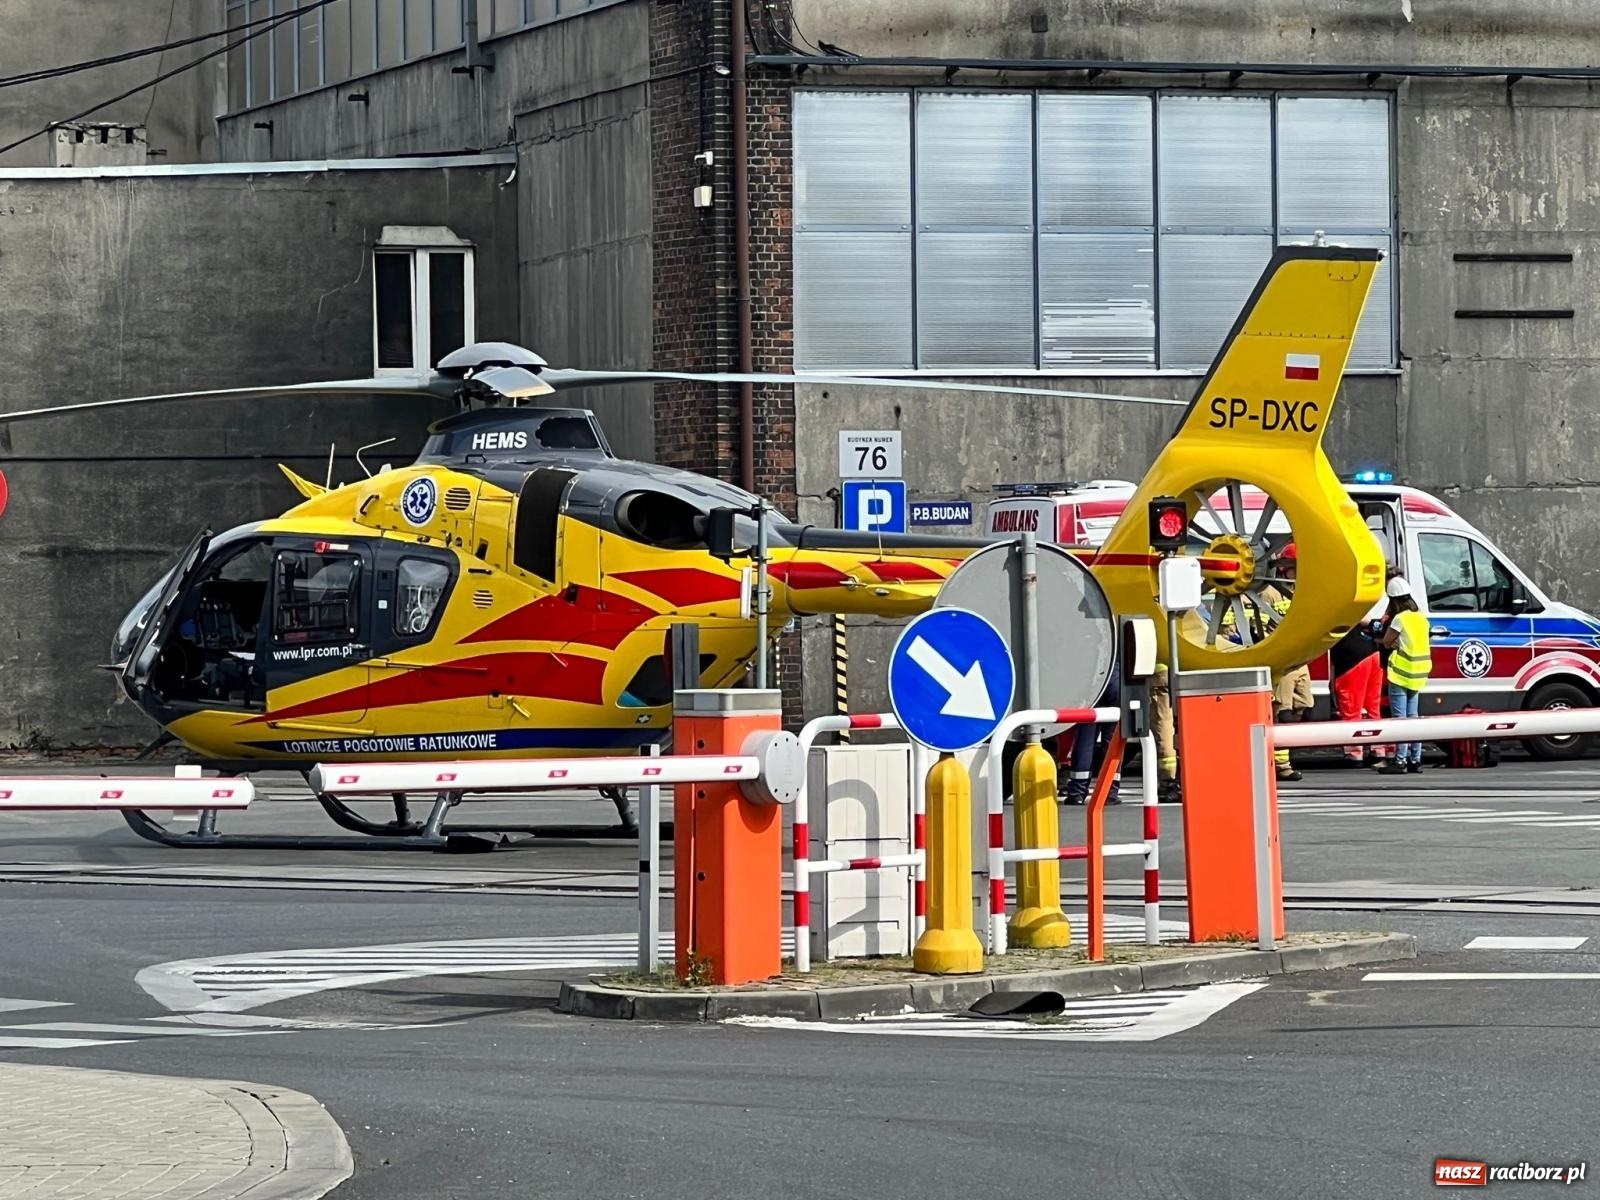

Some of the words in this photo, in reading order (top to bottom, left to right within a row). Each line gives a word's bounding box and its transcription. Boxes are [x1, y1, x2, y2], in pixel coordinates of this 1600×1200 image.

[1209, 397, 1319, 433] SP-DXC
[472, 431, 528, 450] HEMS
[855, 446, 887, 471] 76
[858, 489, 892, 531] P
[913, 506, 969, 521] P.B.BUDAN
[992, 509, 1039, 533] AMBULANS
[273, 643, 352, 661] www.lpr.com.pl
[284, 740, 341, 754] LOTNICZE
[343, 736, 416, 752] POGOTOWIE
[419, 733, 497, 751] RATUNKOWE
